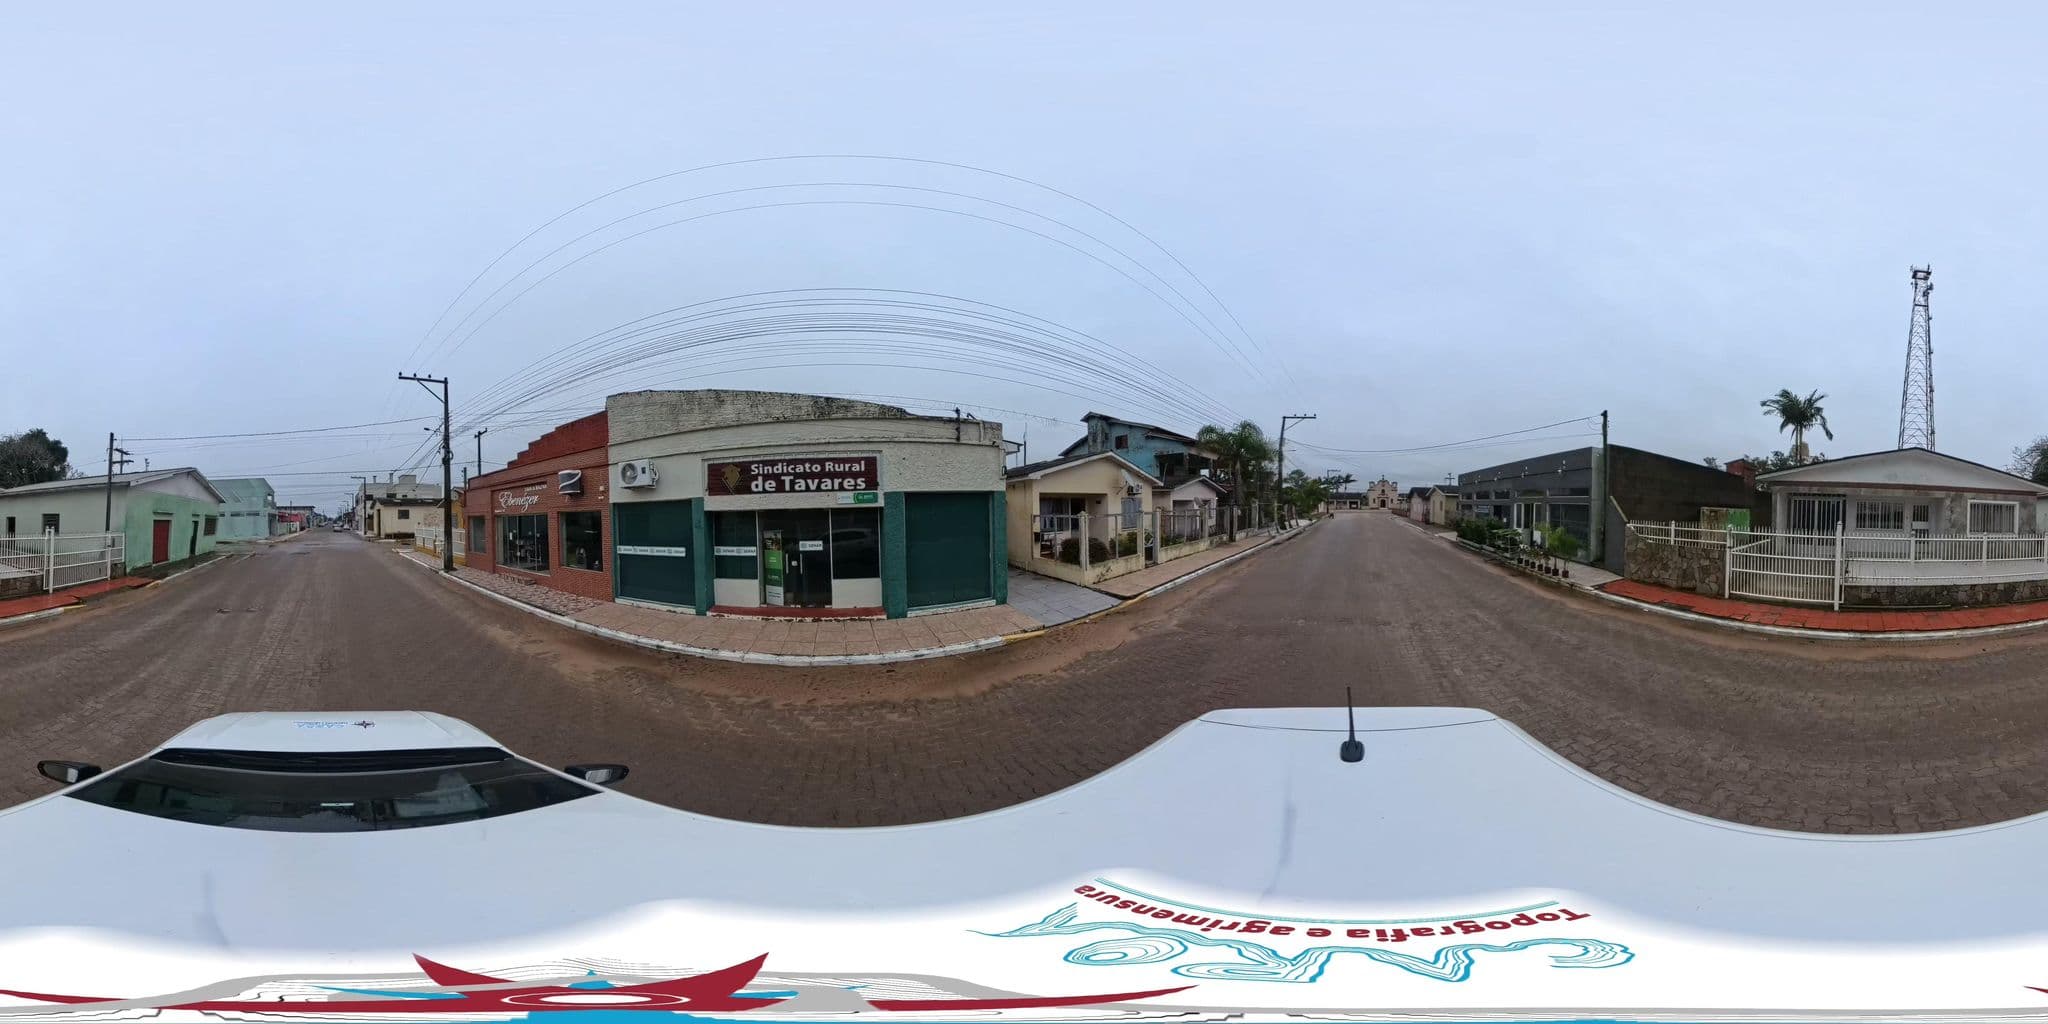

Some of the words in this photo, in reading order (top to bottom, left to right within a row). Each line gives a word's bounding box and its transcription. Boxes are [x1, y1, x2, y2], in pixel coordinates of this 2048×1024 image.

[751, 462, 821, 475] Sindicato
[825, 460, 865, 472] Rural
[751, 476, 776, 492] de
[781, 476, 866, 491] Tavares
